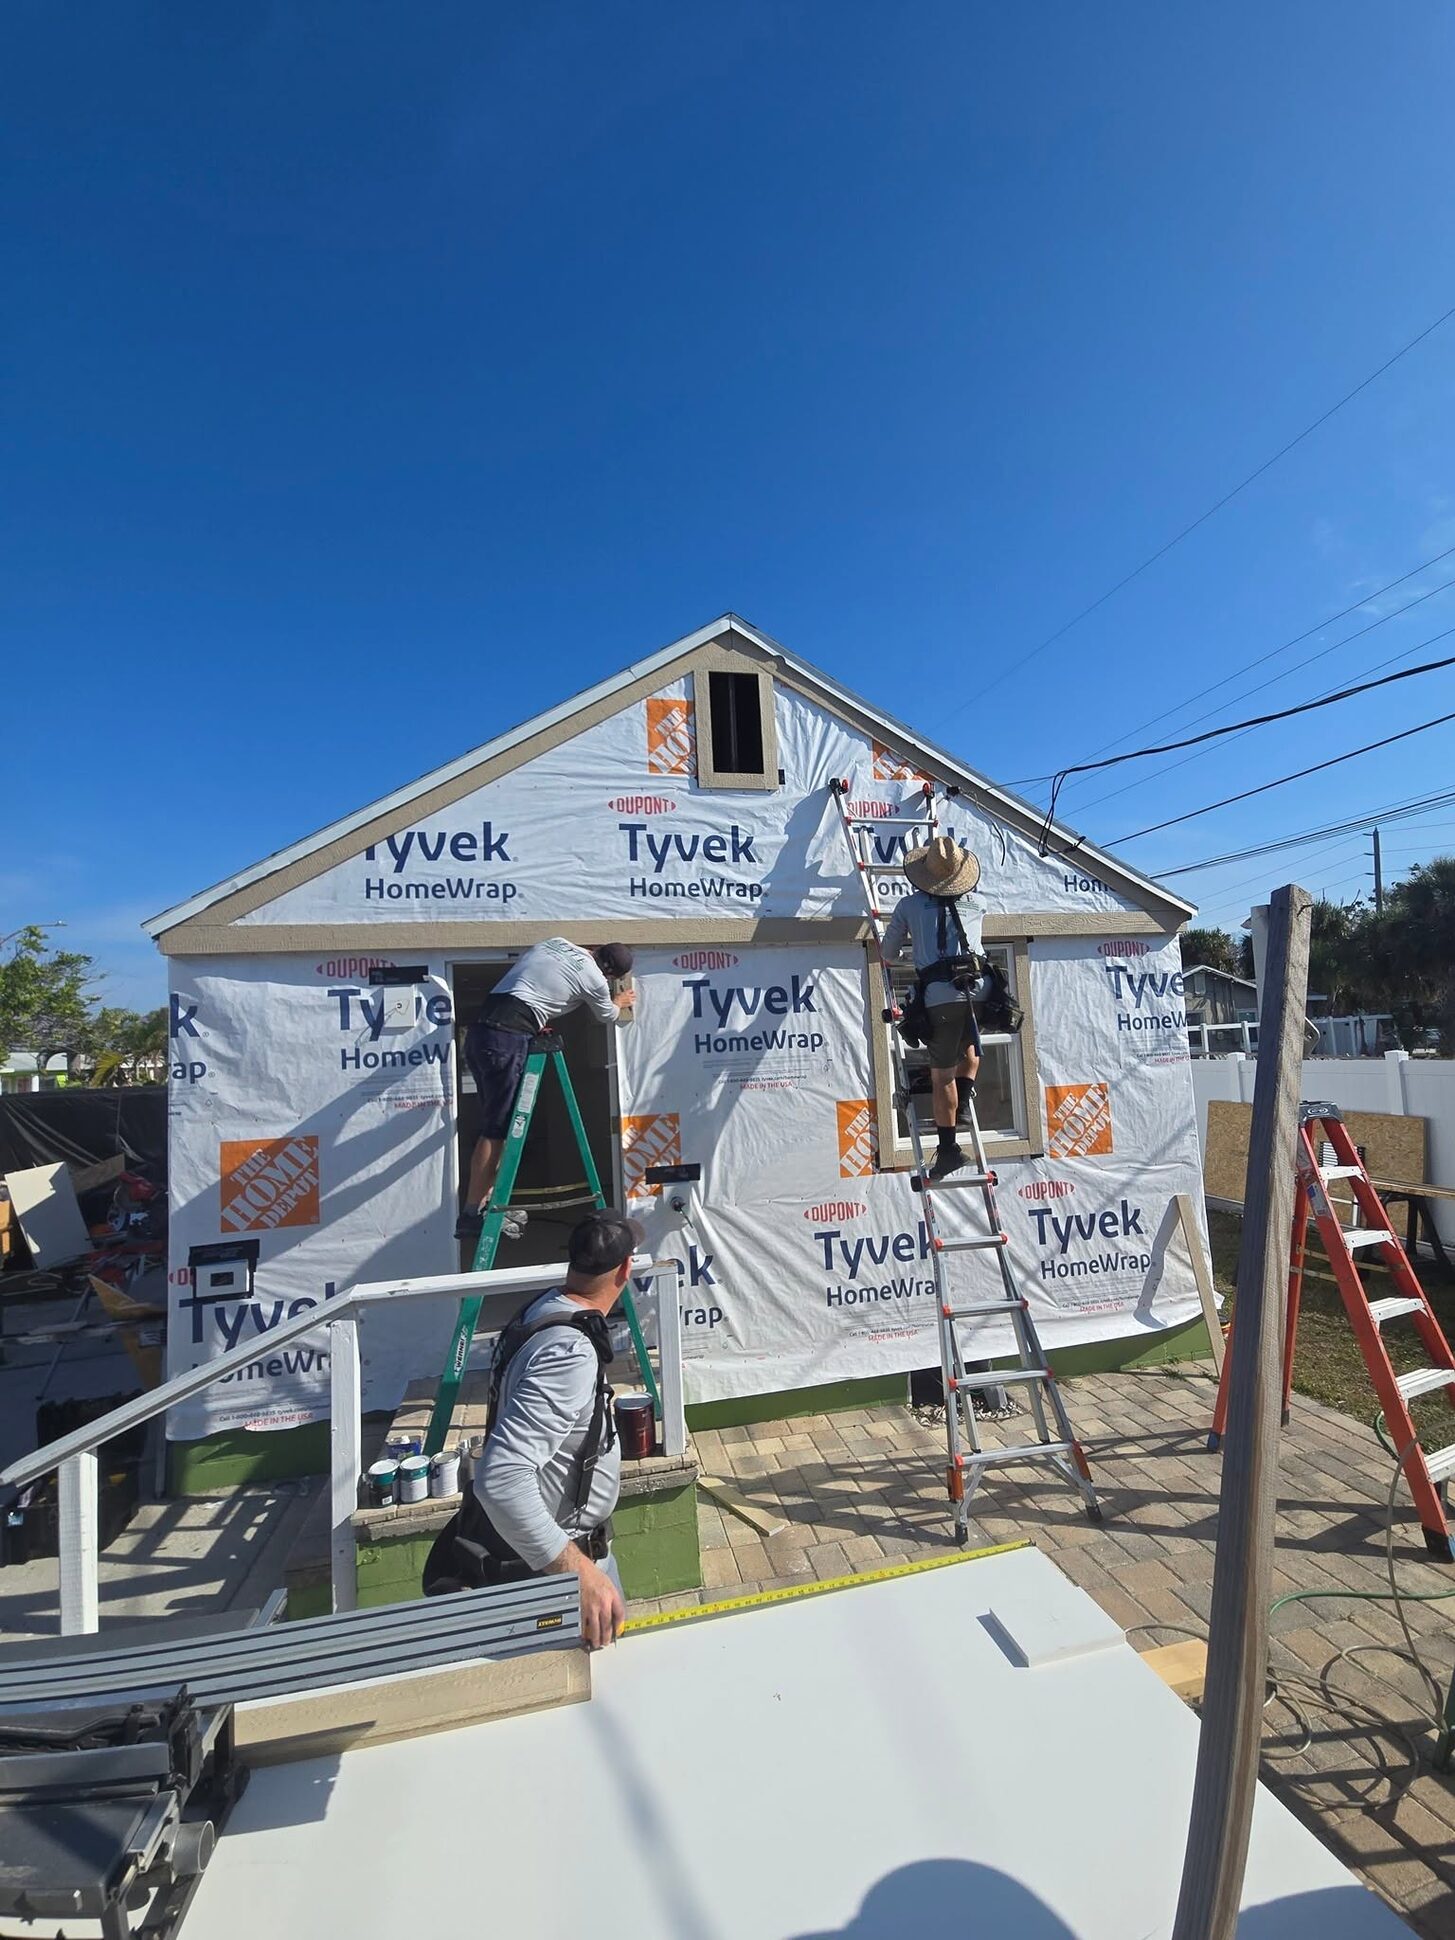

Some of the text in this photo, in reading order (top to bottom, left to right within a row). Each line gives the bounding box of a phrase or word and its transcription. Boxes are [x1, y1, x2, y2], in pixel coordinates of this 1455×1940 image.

[648, 722, 696, 774] HO
[616, 796, 670, 814] DUPONT
[848, 801, 894, 818] DUPONT
[618, 823, 758, 873] Tyvek
[365, 878, 517, 904] HomeWrap
[629, 877, 763, 902] HomeWrap
[1064, 875, 1114, 892] Hom
[682, 952, 731, 971] DUPONT
[1103, 941, 1145, 957] DUPONT
[327, 989, 452, 1041] Tye
[682, 975, 817, 1029] Tyvek
[695, 1030, 823, 1053] HomeWrap
[1049, 1084, 1108, 1158] HOME
[230, 1147, 271, 1185] THE
[840, 1122, 879, 1177] HO
[222, 1138, 319, 1231] HOME
[259, 1168, 319, 1229] DEPOT
[1025, 1181, 1069, 1199] DUPONT
[812, 1201, 860, 1222] DUPONT
[1028, 1200, 1145, 1254] Tyvek
[1040, 1251, 1151, 1280] HomeWrap
[179, 1282, 335, 1353] Tyv
